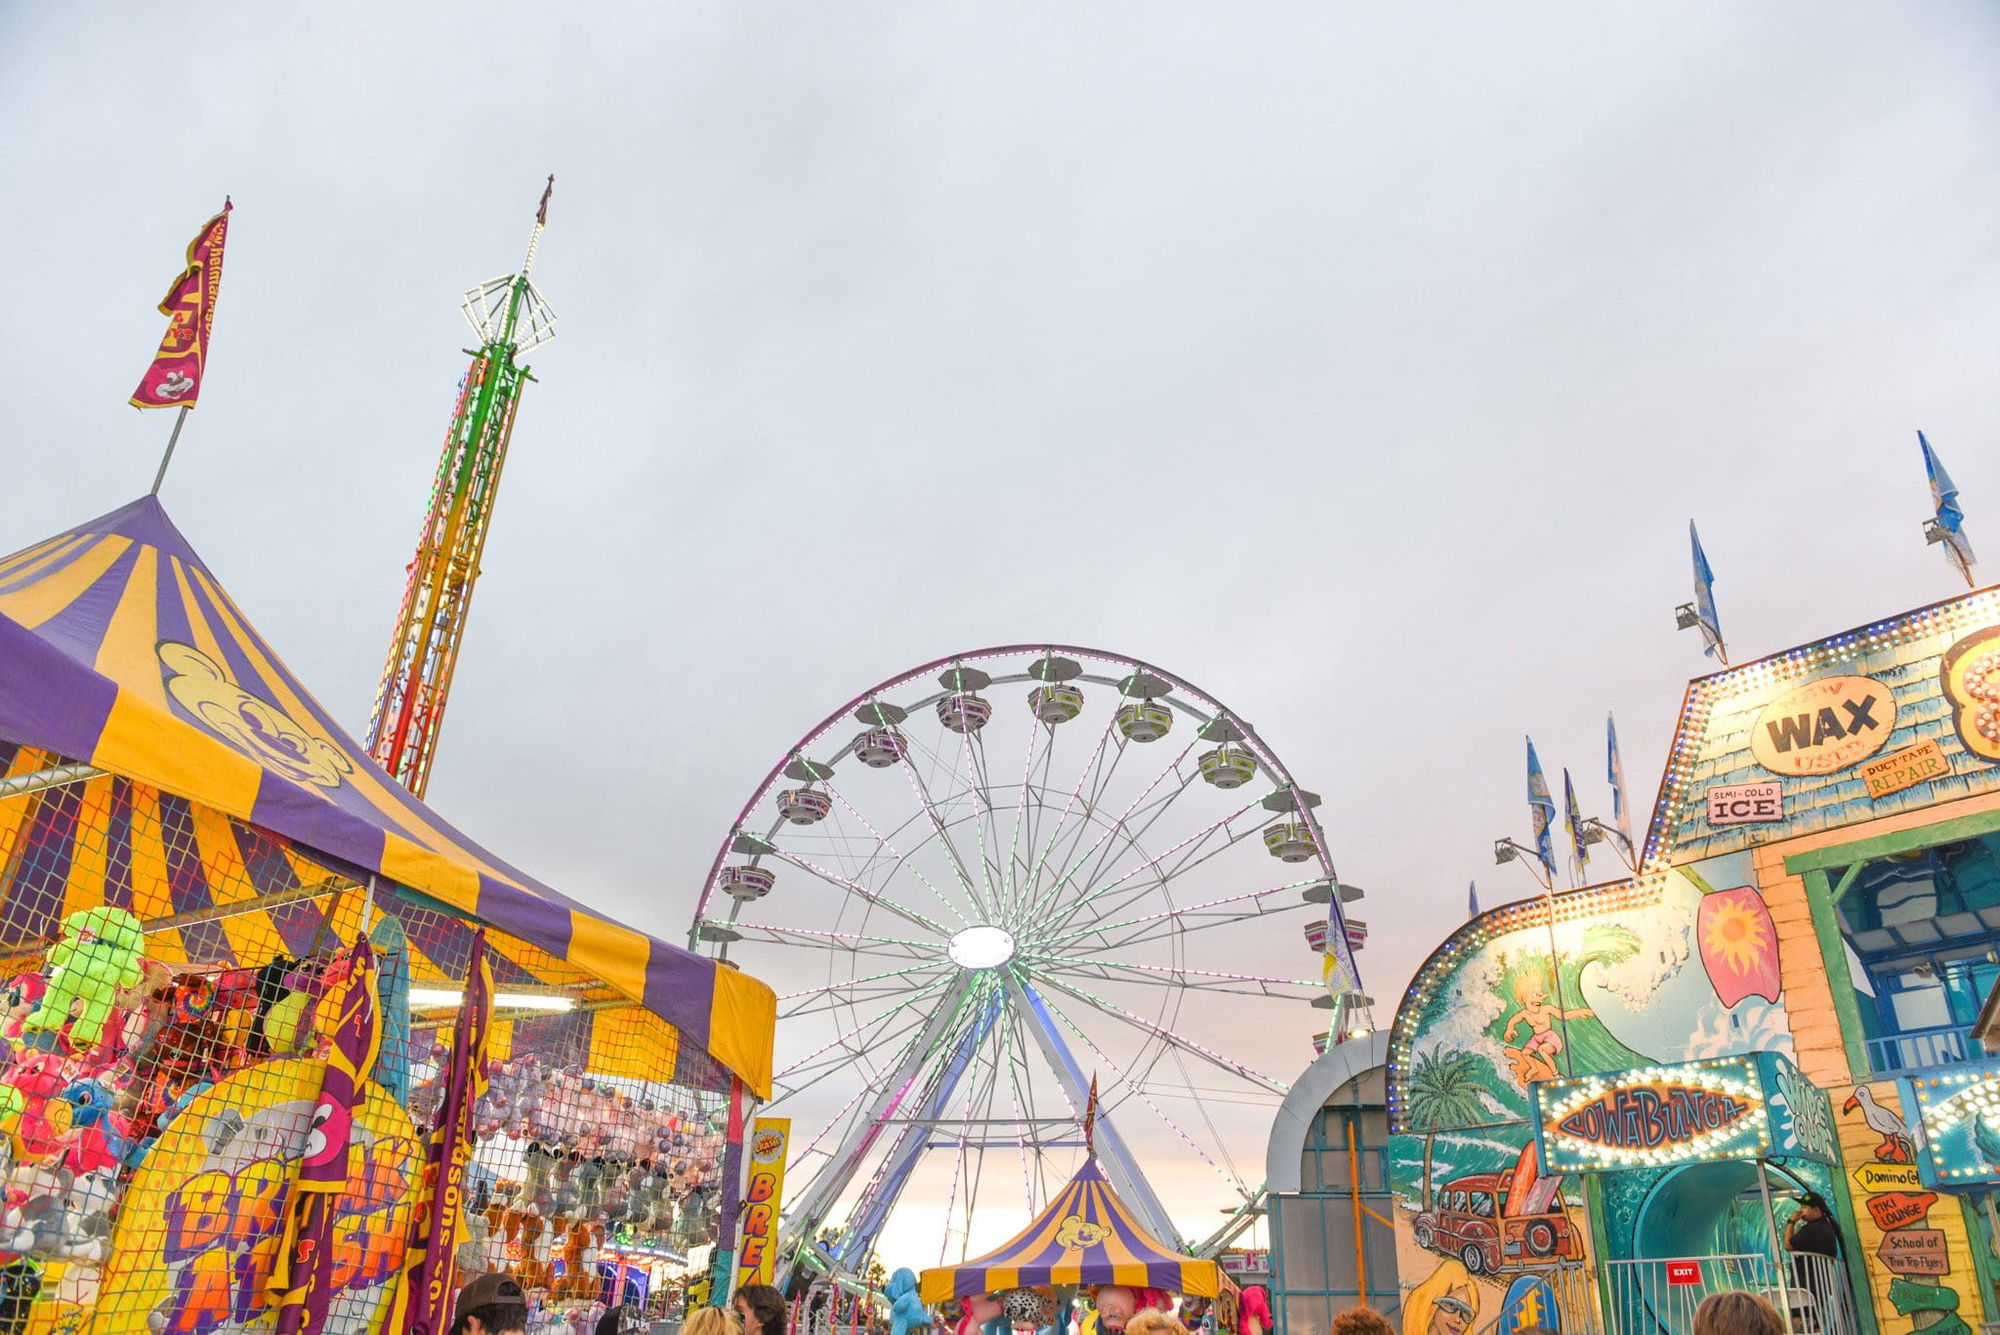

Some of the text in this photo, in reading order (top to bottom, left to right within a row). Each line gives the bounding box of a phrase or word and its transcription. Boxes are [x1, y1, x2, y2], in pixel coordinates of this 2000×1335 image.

[1766, 694, 1879, 754] WAX
[1794, 741, 1866, 770] USED
[1866, 745, 1933, 776] DUCT TAPE
[1871, 758, 1941, 793] REPAIR
[1713, 788, 1775, 800] SEMI-COLD
[1714, 799, 1776, 818] ICE
[1775, 1072, 1827, 1129] WIPE
[1560, 1088, 1748, 1151] COWABUNGA
[1865, 1169, 1907, 1185] Domino
[1873, 1198, 1897, 1214] TIKI
[1881, 1203, 1922, 1226] LOUNGE
[1890, 1236, 1938, 1249] School of
[1673, 1267, 1694, 1277] EXIT
